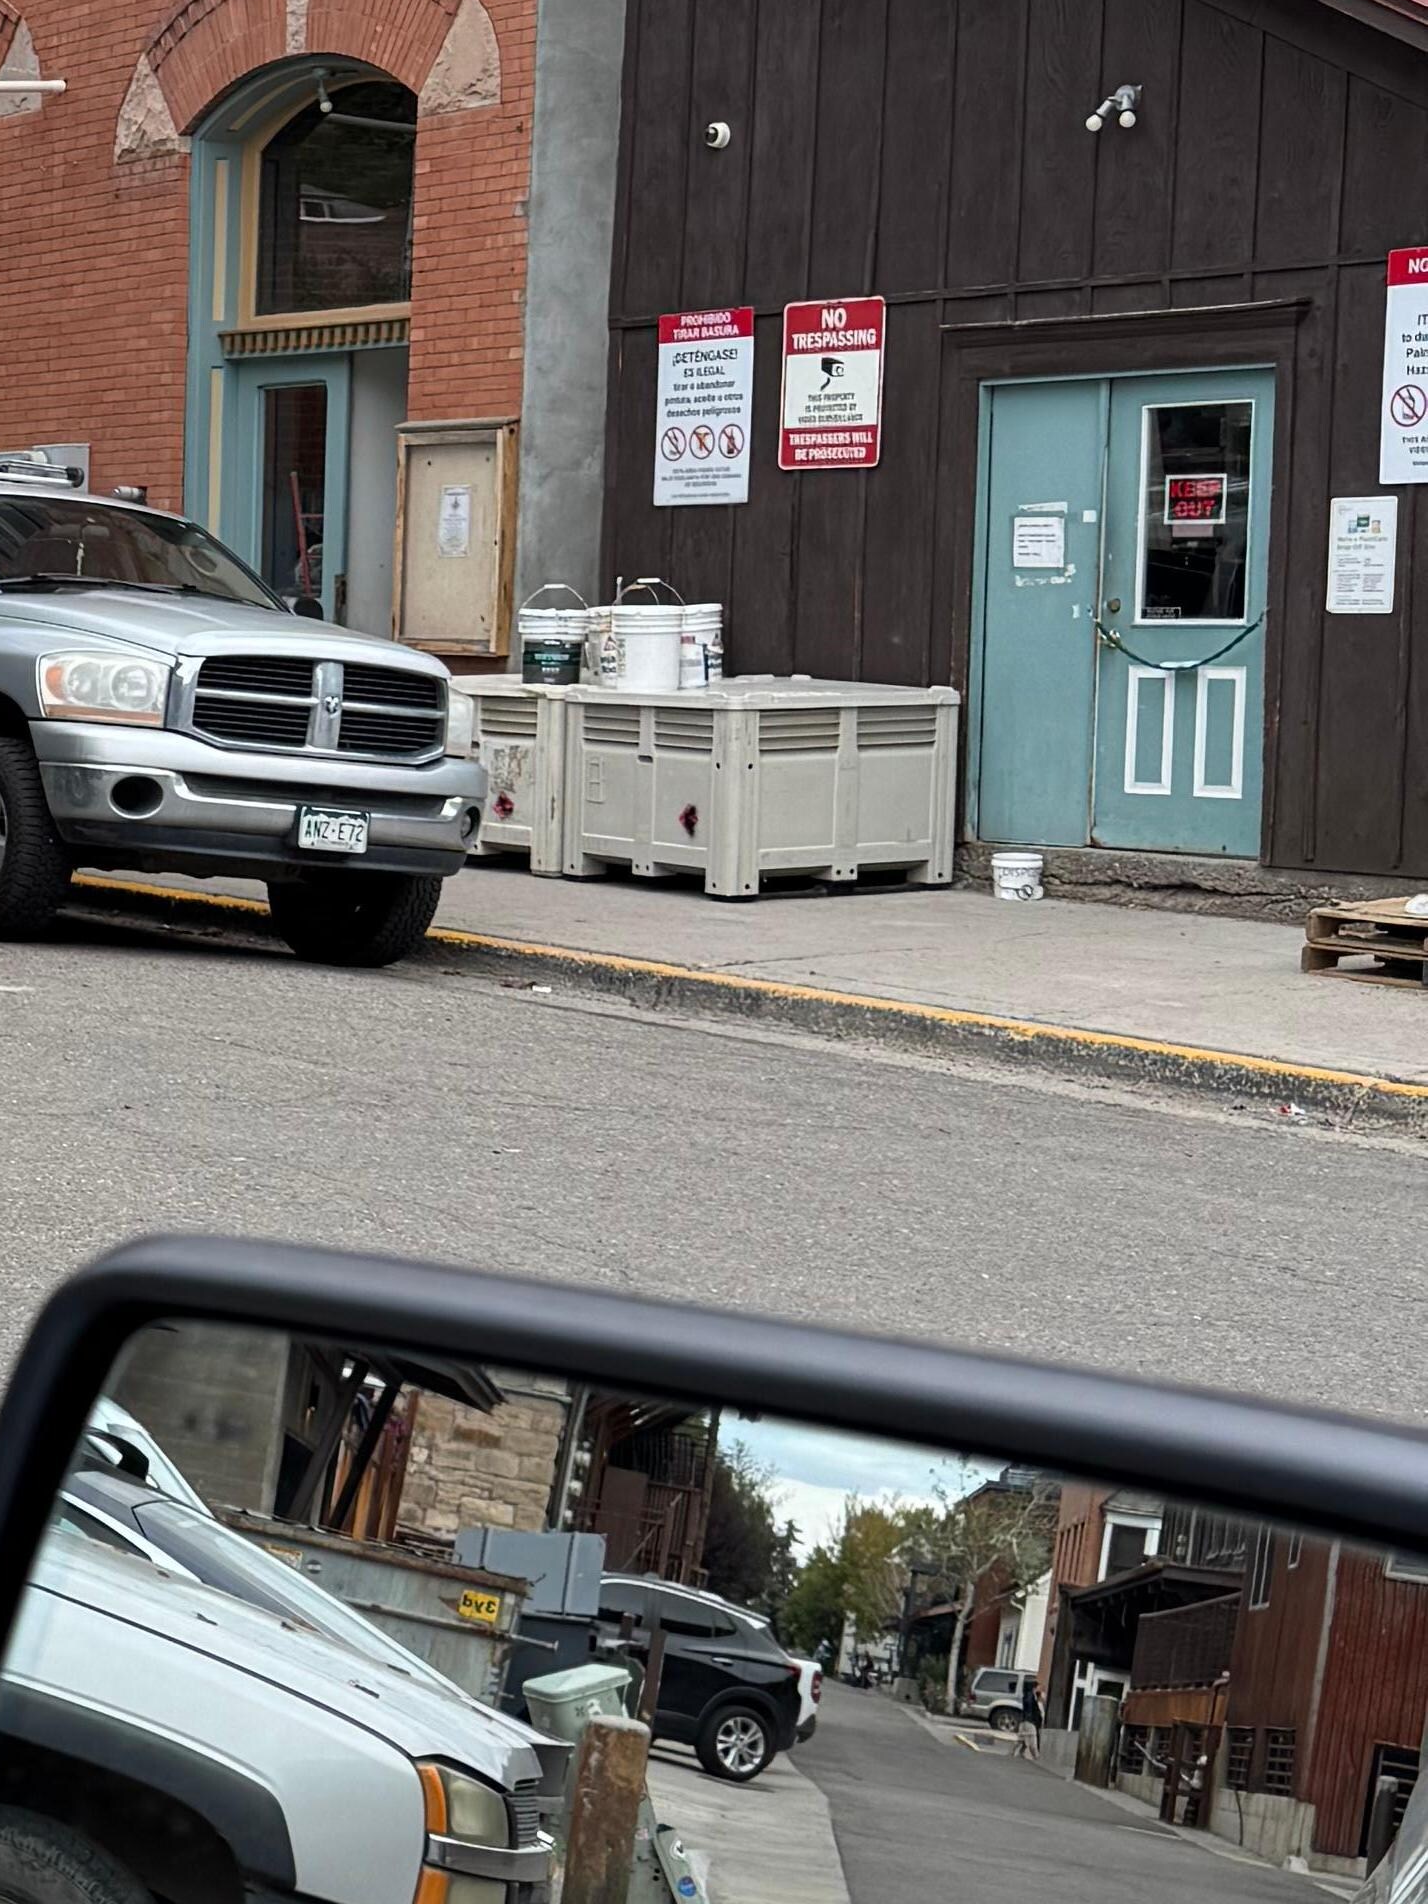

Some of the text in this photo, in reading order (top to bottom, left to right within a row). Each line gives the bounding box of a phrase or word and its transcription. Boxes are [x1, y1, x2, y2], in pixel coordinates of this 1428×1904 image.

[821, 308, 847, 329] NO
[792, 329, 876, 350] TRESPASSING
[789, 431, 873, 446] TRESPASSERS WILL
[794, 446, 866, 461] BE PROSECUTED
[1170, 480, 1222, 498] KEEP
[1173, 500, 1215, 517] OUT
